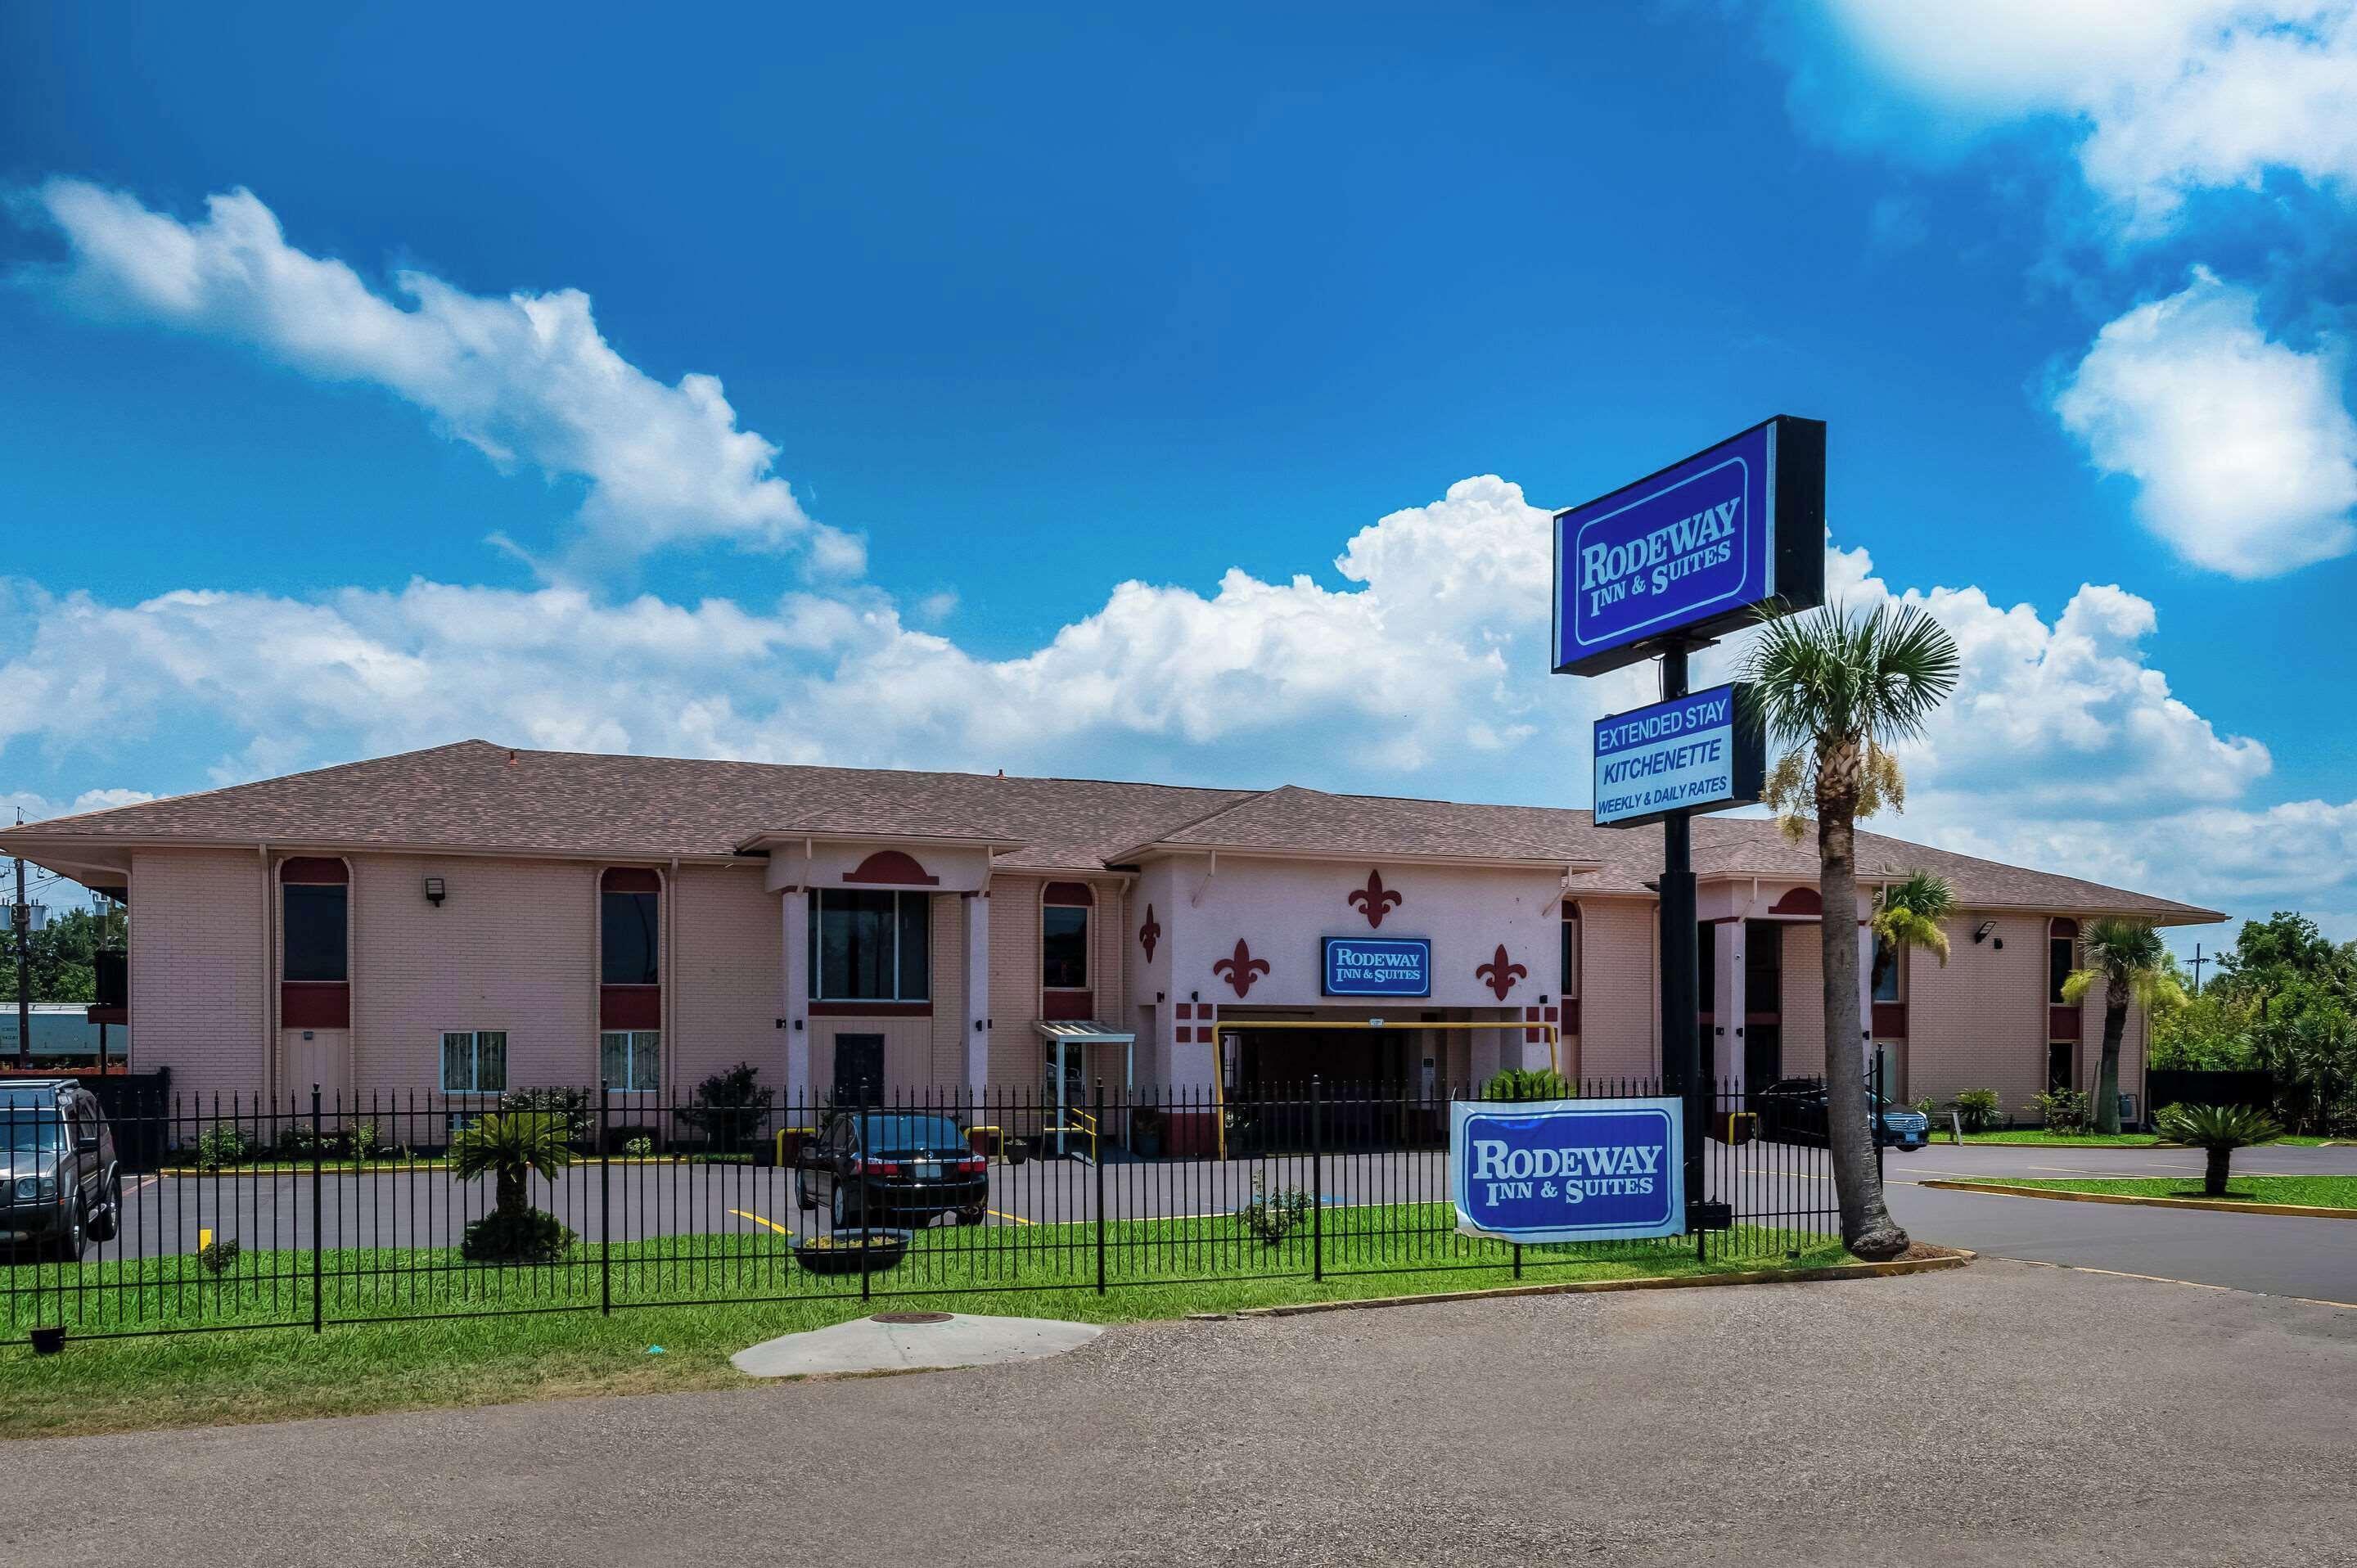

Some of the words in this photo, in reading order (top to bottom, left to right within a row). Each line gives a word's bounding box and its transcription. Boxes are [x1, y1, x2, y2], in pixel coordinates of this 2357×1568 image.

[1581, 496, 1741, 592] RODEWAY
[1590, 580, 1626, 618] INN
[1631, 575, 1647, 596] &
[1652, 540, 1731, 596] SUITES
[1598, 711, 1682, 751] EXTENDED
[1686, 698, 1728, 728] STAY
[1603, 737, 1722, 786] KITCHENETTE
[1598, 791, 1643, 815] WEEKLY
[1643, 791, 1652, 806] &
[1653, 783, 1688, 804] DAILY
[1688, 775, 1728, 797] RATES
[1336, 948, 1420, 967] RODEWAY
[1336, 968, 1362, 982] INN
[1363, 968, 1373, 980] &
[1374, 969, 1421, 983] SUITES
[1473, 1139, 1663, 1180] RODEWAY
[1485, 1182, 1534, 1206] INN
[1540, 1180, 1558, 1199] &
[1565, 1177, 1653, 1205] SUITES
